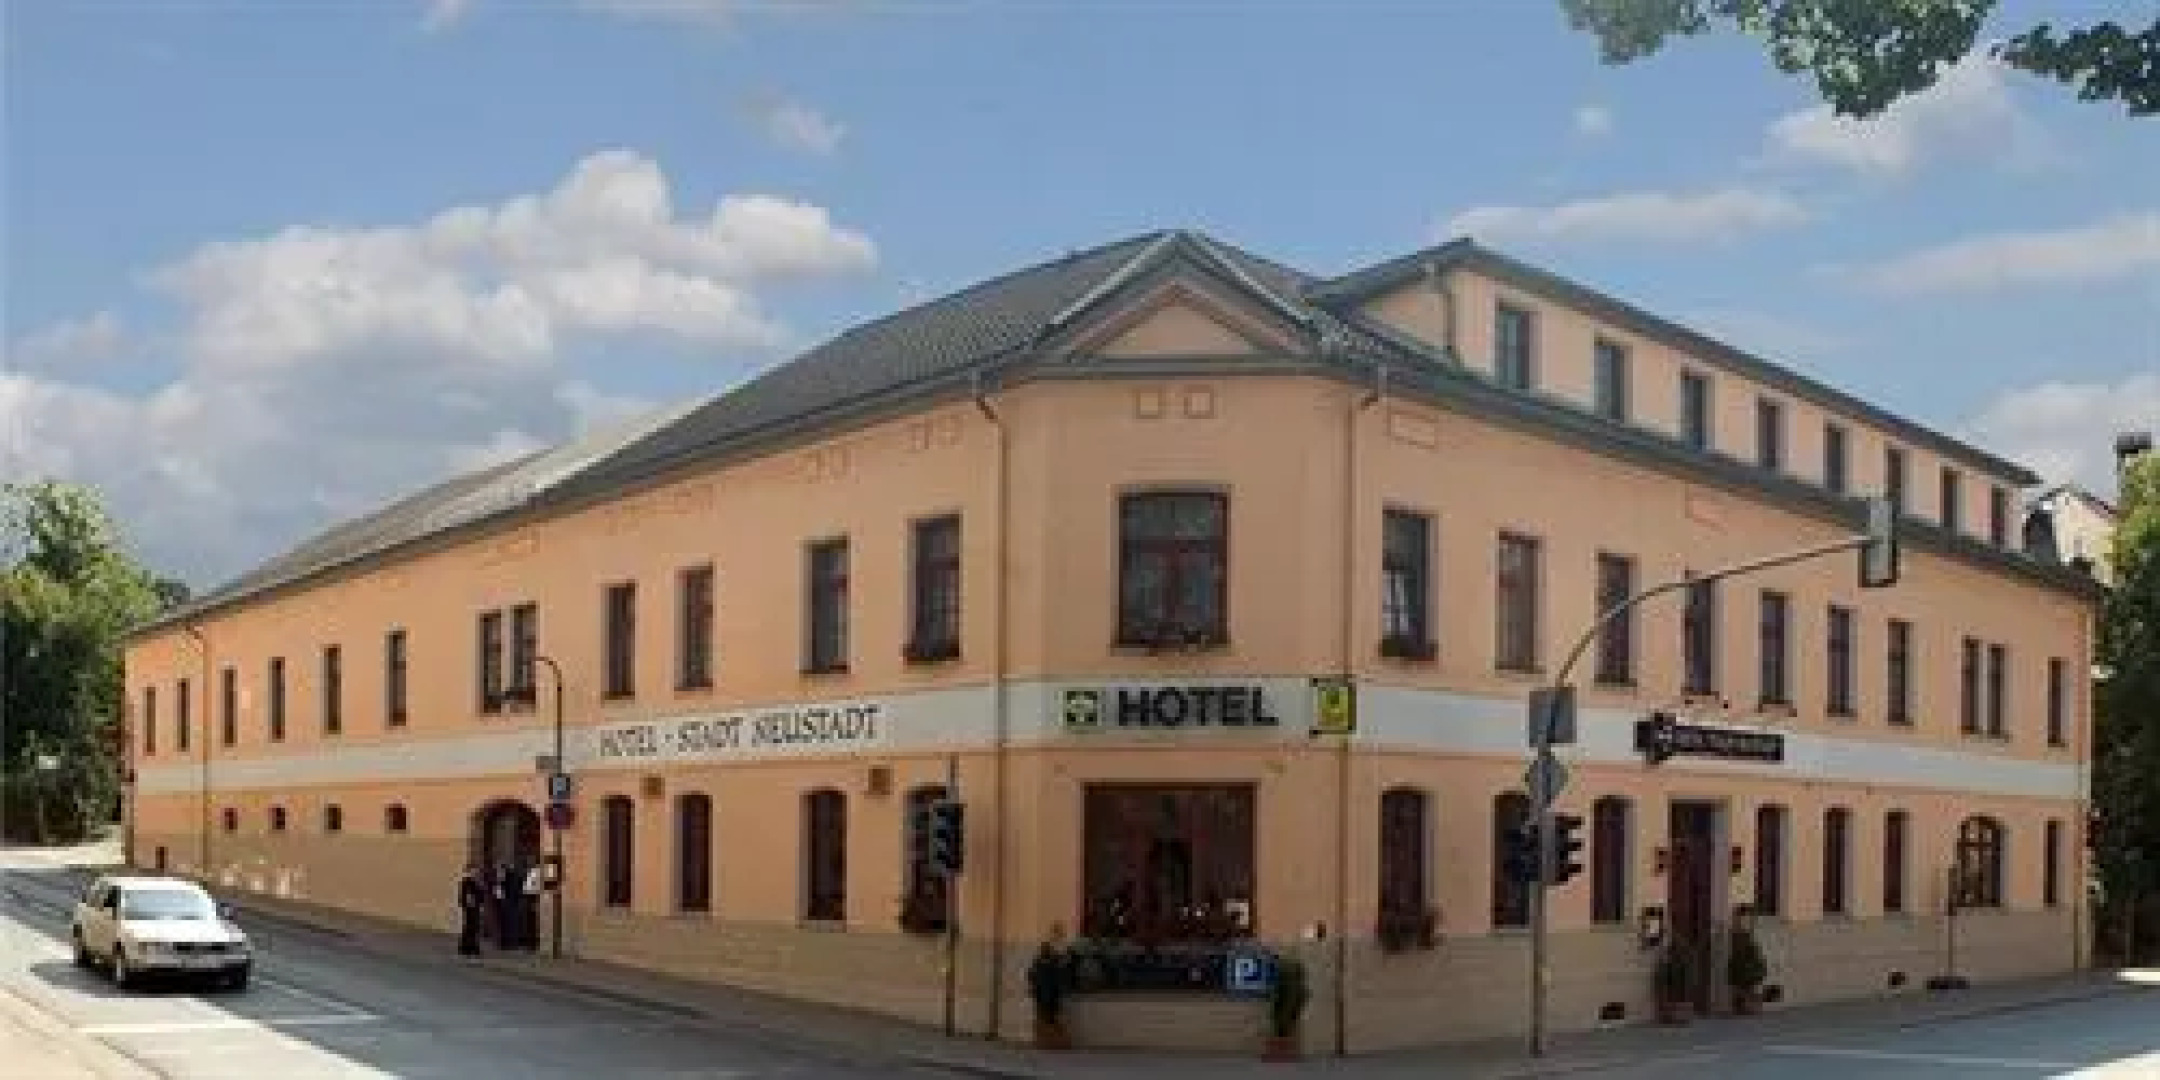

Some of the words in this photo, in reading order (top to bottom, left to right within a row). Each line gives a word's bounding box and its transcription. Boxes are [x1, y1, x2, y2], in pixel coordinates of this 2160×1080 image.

[1117, 686, 1279, 727] HOTEL
[599, 725, 658, 757] HOTEL
[677, 716, 744, 752] STADT
[751, 704, 880, 747] NEUSTADT
